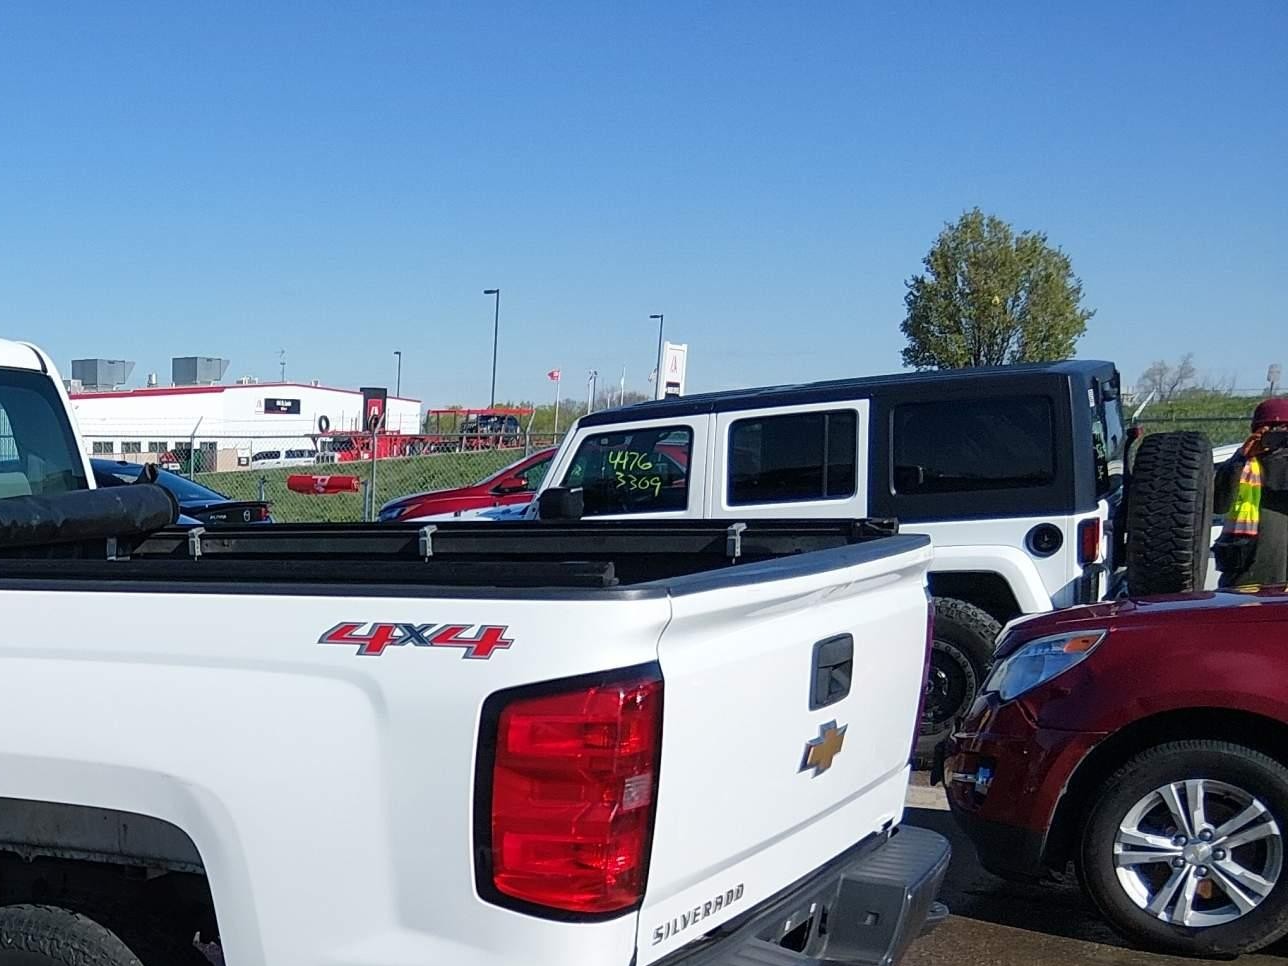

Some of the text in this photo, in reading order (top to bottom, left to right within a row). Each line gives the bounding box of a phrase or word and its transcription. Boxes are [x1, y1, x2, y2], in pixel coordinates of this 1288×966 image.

[608, 450, 653, 471] 4476
[615, 472, 662, 497] 3309
[652, 883, 744, 946] SILVERADO
